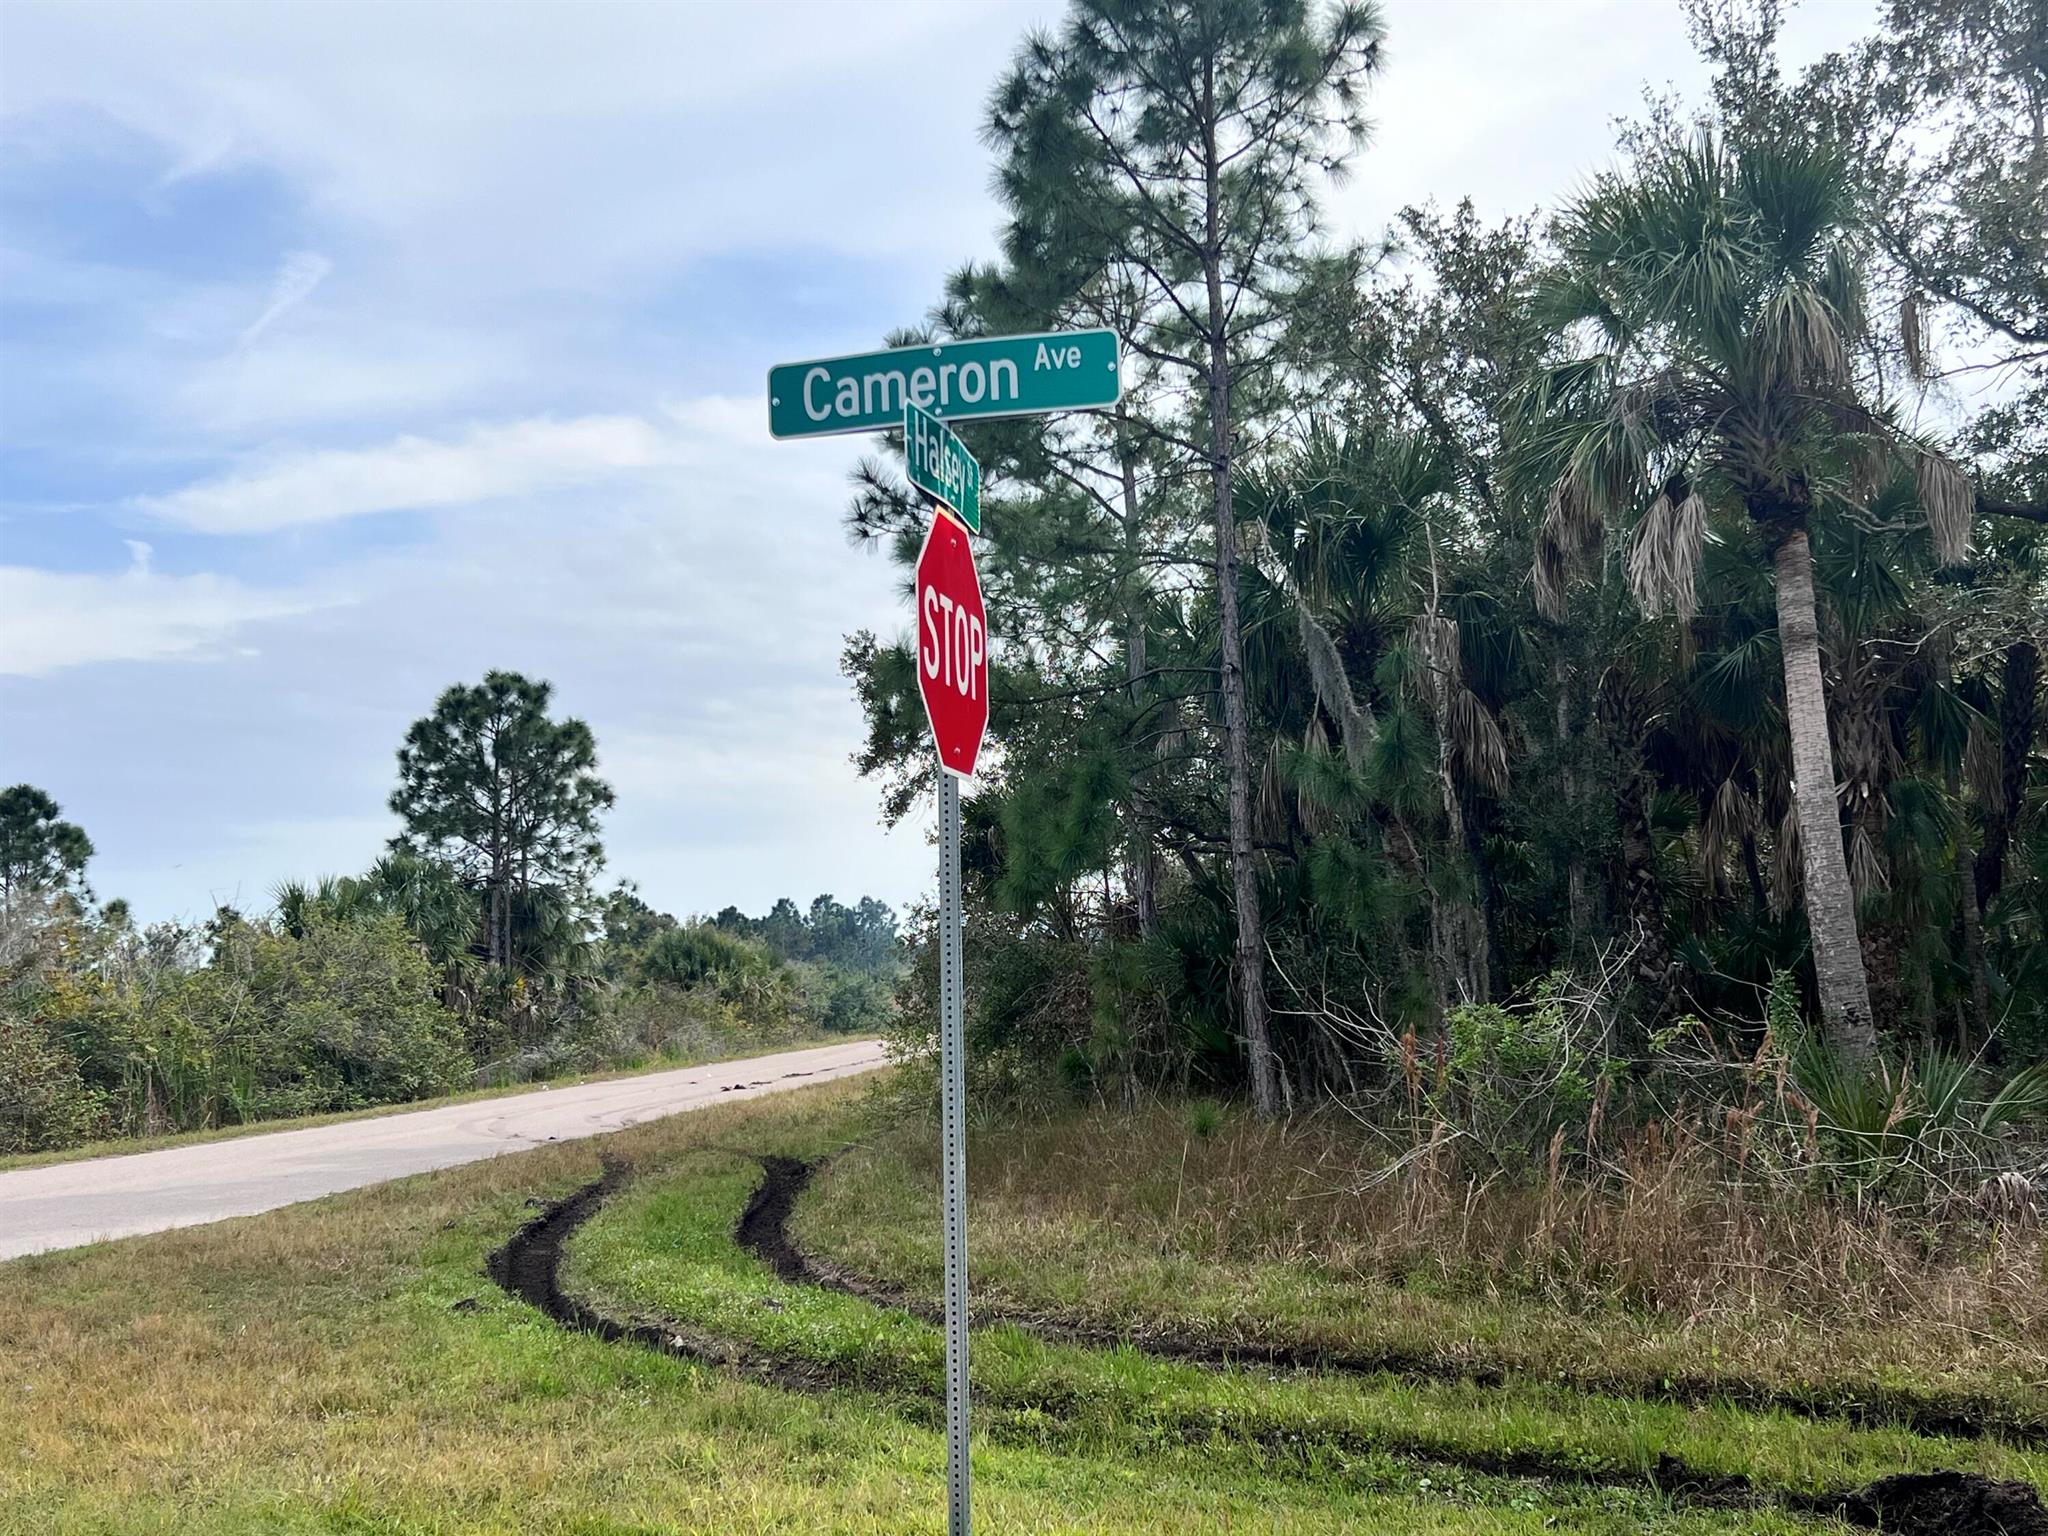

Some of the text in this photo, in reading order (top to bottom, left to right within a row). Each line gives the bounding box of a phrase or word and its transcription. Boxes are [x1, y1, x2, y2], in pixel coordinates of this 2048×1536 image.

[803, 342, 1082, 421] Cameron Ave
[914, 409, 966, 514] Halsey
[923, 585, 983, 700] STOP
